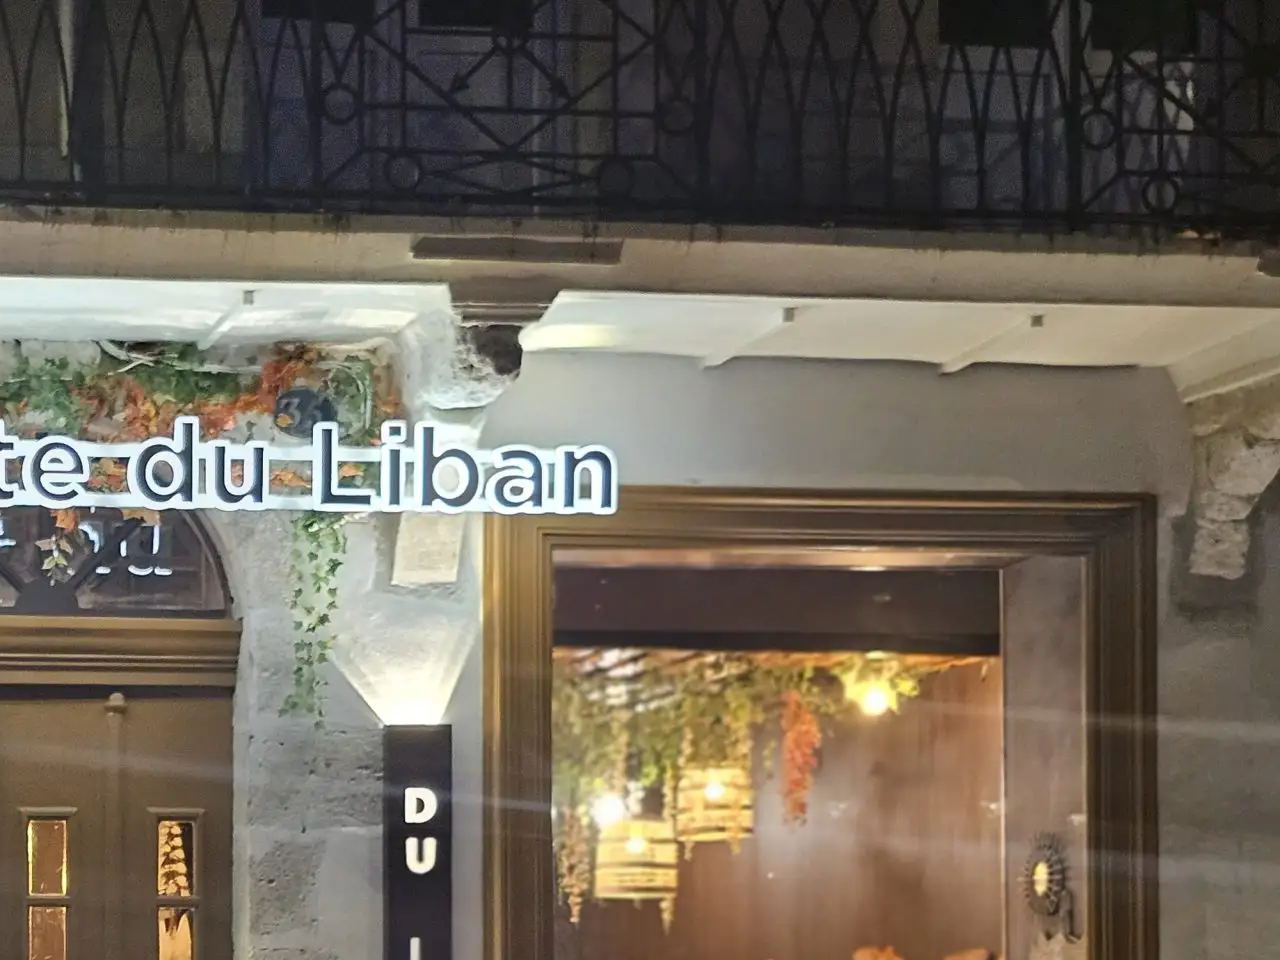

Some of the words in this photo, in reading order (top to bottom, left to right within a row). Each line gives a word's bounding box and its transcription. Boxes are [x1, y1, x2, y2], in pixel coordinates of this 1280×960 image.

[127, 418, 268, 507] du
[317, 422, 614, 512] Liban
[403, 786, 438, 875] DU
